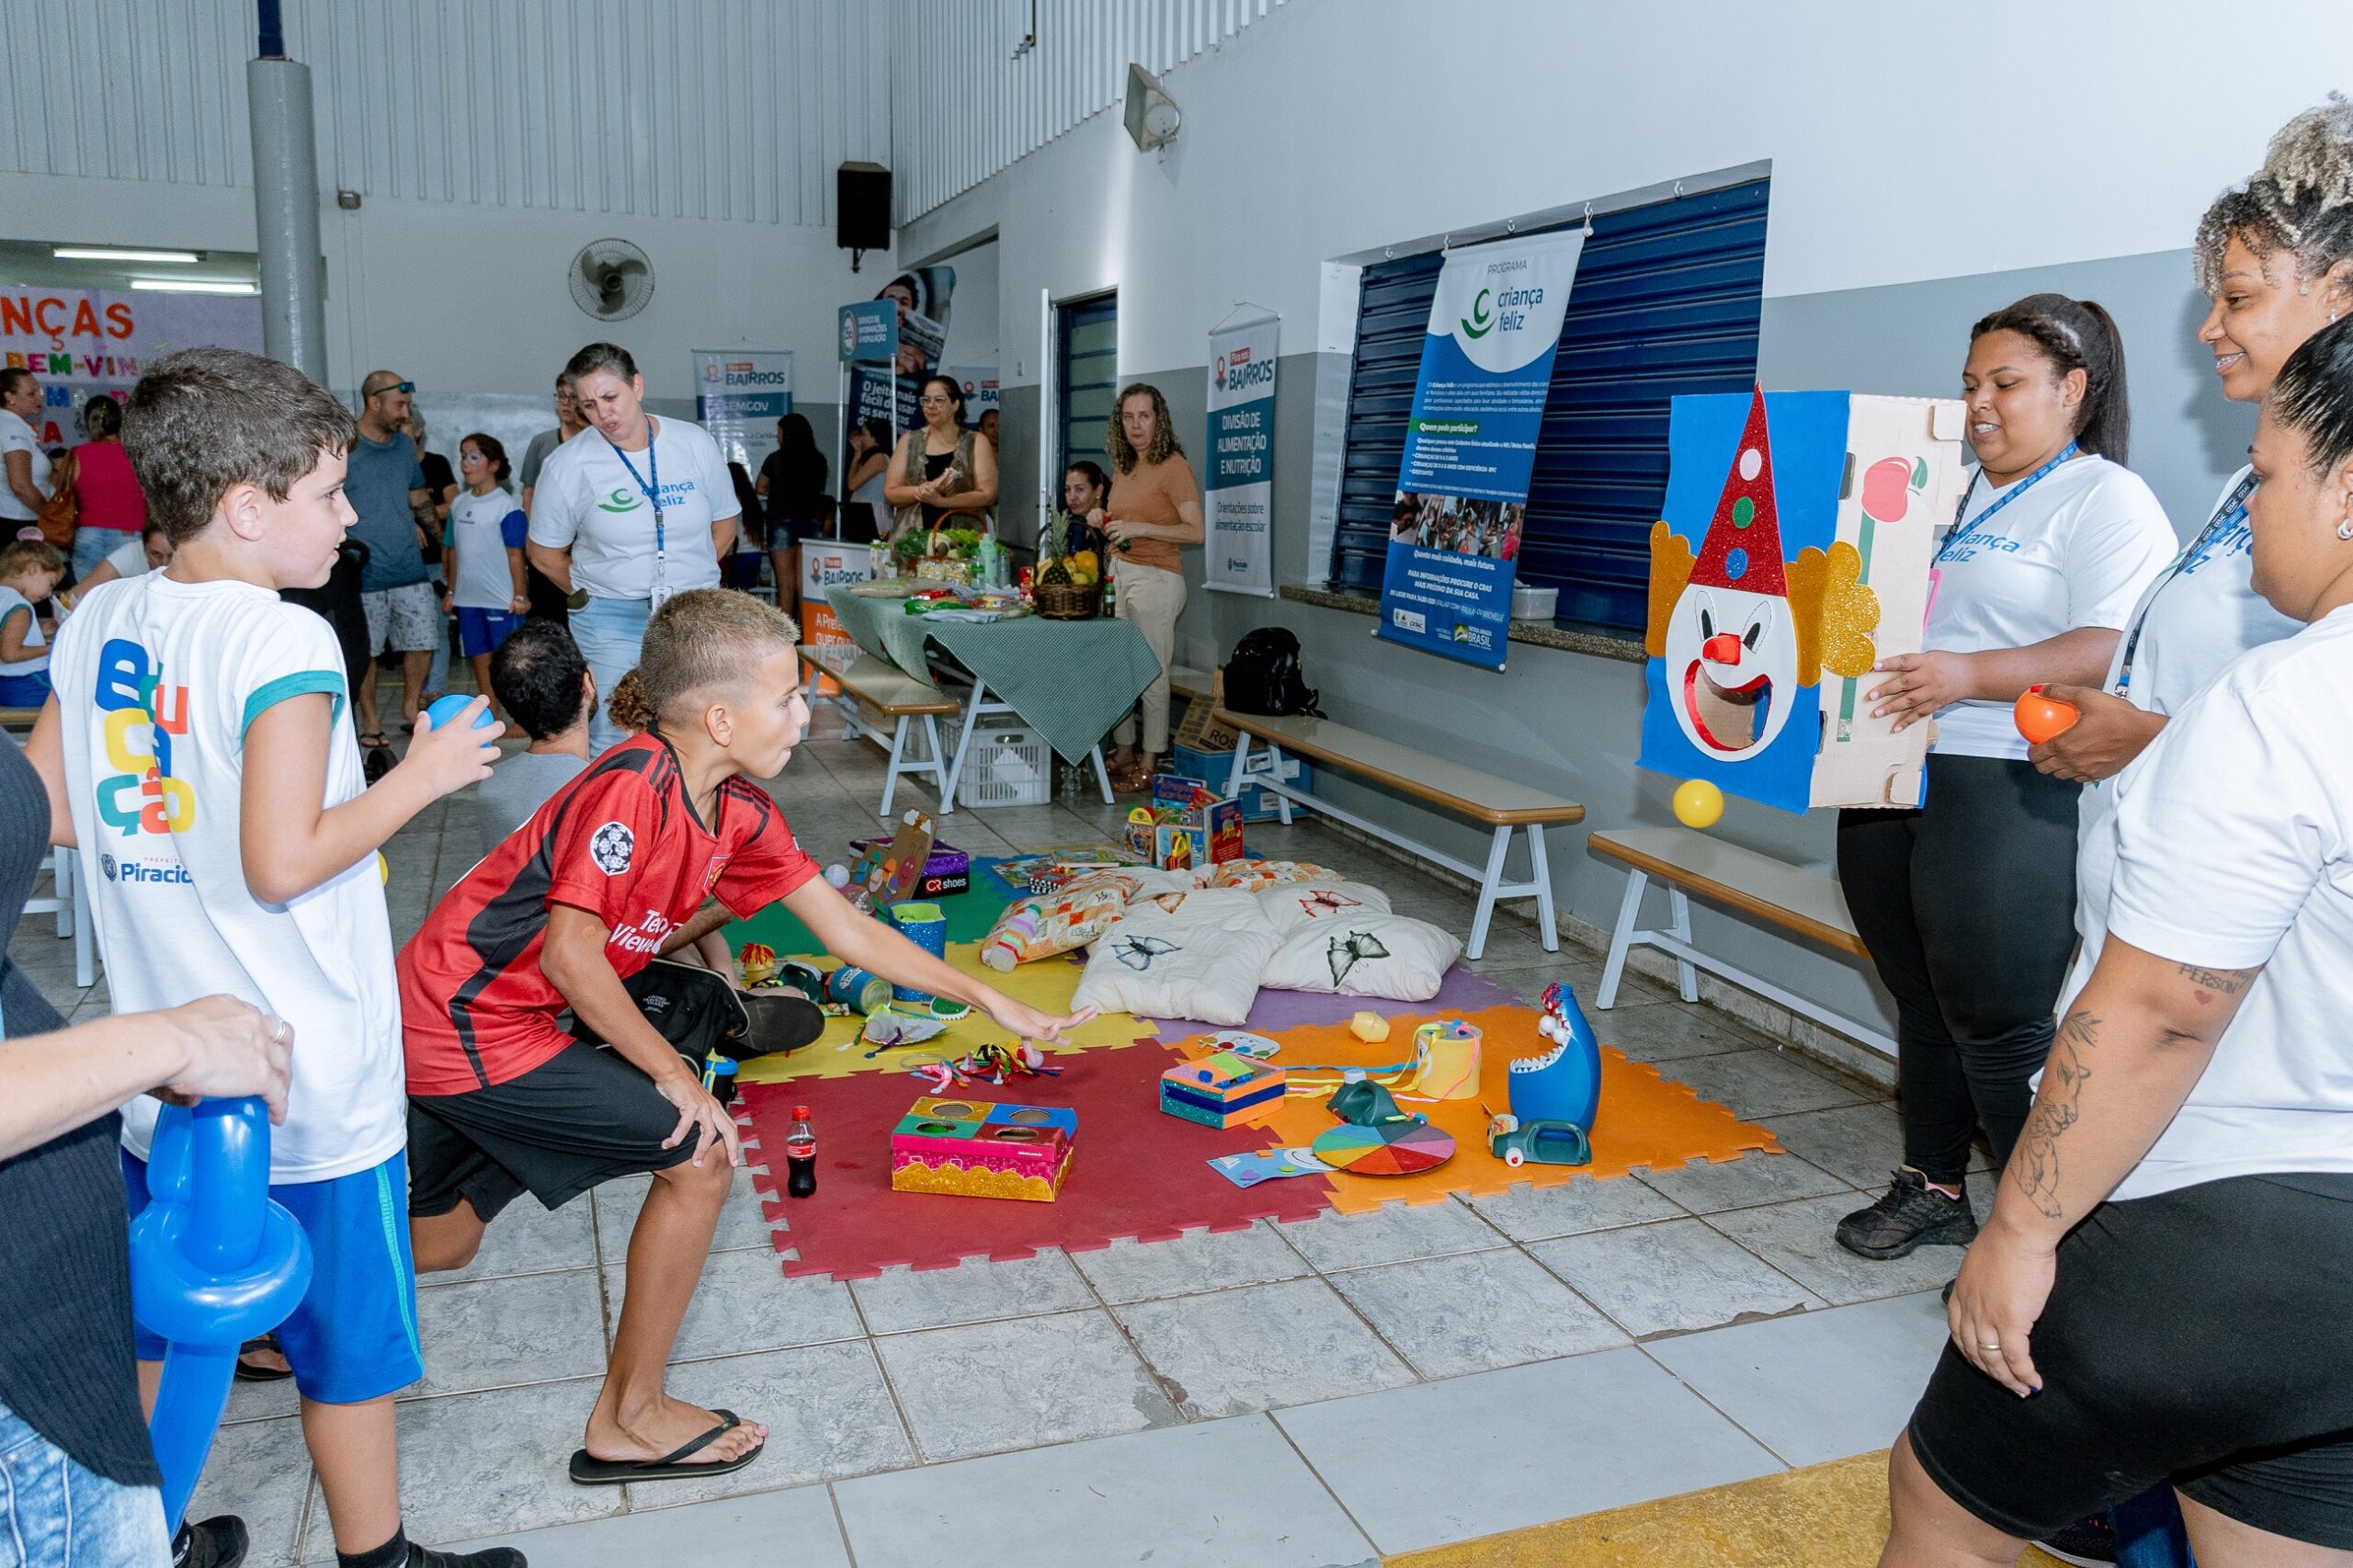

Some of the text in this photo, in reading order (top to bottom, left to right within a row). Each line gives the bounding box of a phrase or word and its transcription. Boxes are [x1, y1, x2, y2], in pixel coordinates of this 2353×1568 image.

[1488, 260, 1527, 275] PROGRAMA
[1498, 287, 1543, 310] criança
[0, 297, 133, 351] NÇAS
[1499, 311, 1524, 332] feliz
[726, 372, 785, 385] BAIRROS
[1229, 359, 1273, 391] BAIRROS
[861, 392, 882, 407] fácil
[898, 403, 916, 415] usar
[897, 391, 916, 404] mais
[982, 390, 1000, 402] BA
[859, 406, 871, 415] os
[1222, 411, 1261, 430] DIVISÃO DE
[1419, 423, 1478, 434] Quem pode participar?
[1218, 432, 1267, 453] ALIMENTAÇÃO
[1221, 455, 1261, 476] E NUTRIÇÃO
[642, 482, 695, 496] cança
[657, 494, 686, 506] eliz
[2226, 499, 2239, 513] CESAC
[1218, 501, 1265, 516] Orientações sobre
[1215, 518, 1266, 533] alimentação escolar
[2214, 514, 2227, 528] CESAC
[1940, 531, 2020, 552] ciança
[1939, 547, 1977, 562] eliz
[1464, 558, 1477, 567] mais
[1450, 577, 1473, 589] PROCURE
[816, 613, 823, 627] A
[1468, 632, 1492, 647] BRASIL
[926, 878, 967, 892] CR shoes
[2178, 964, 2237, 994] PERSON
